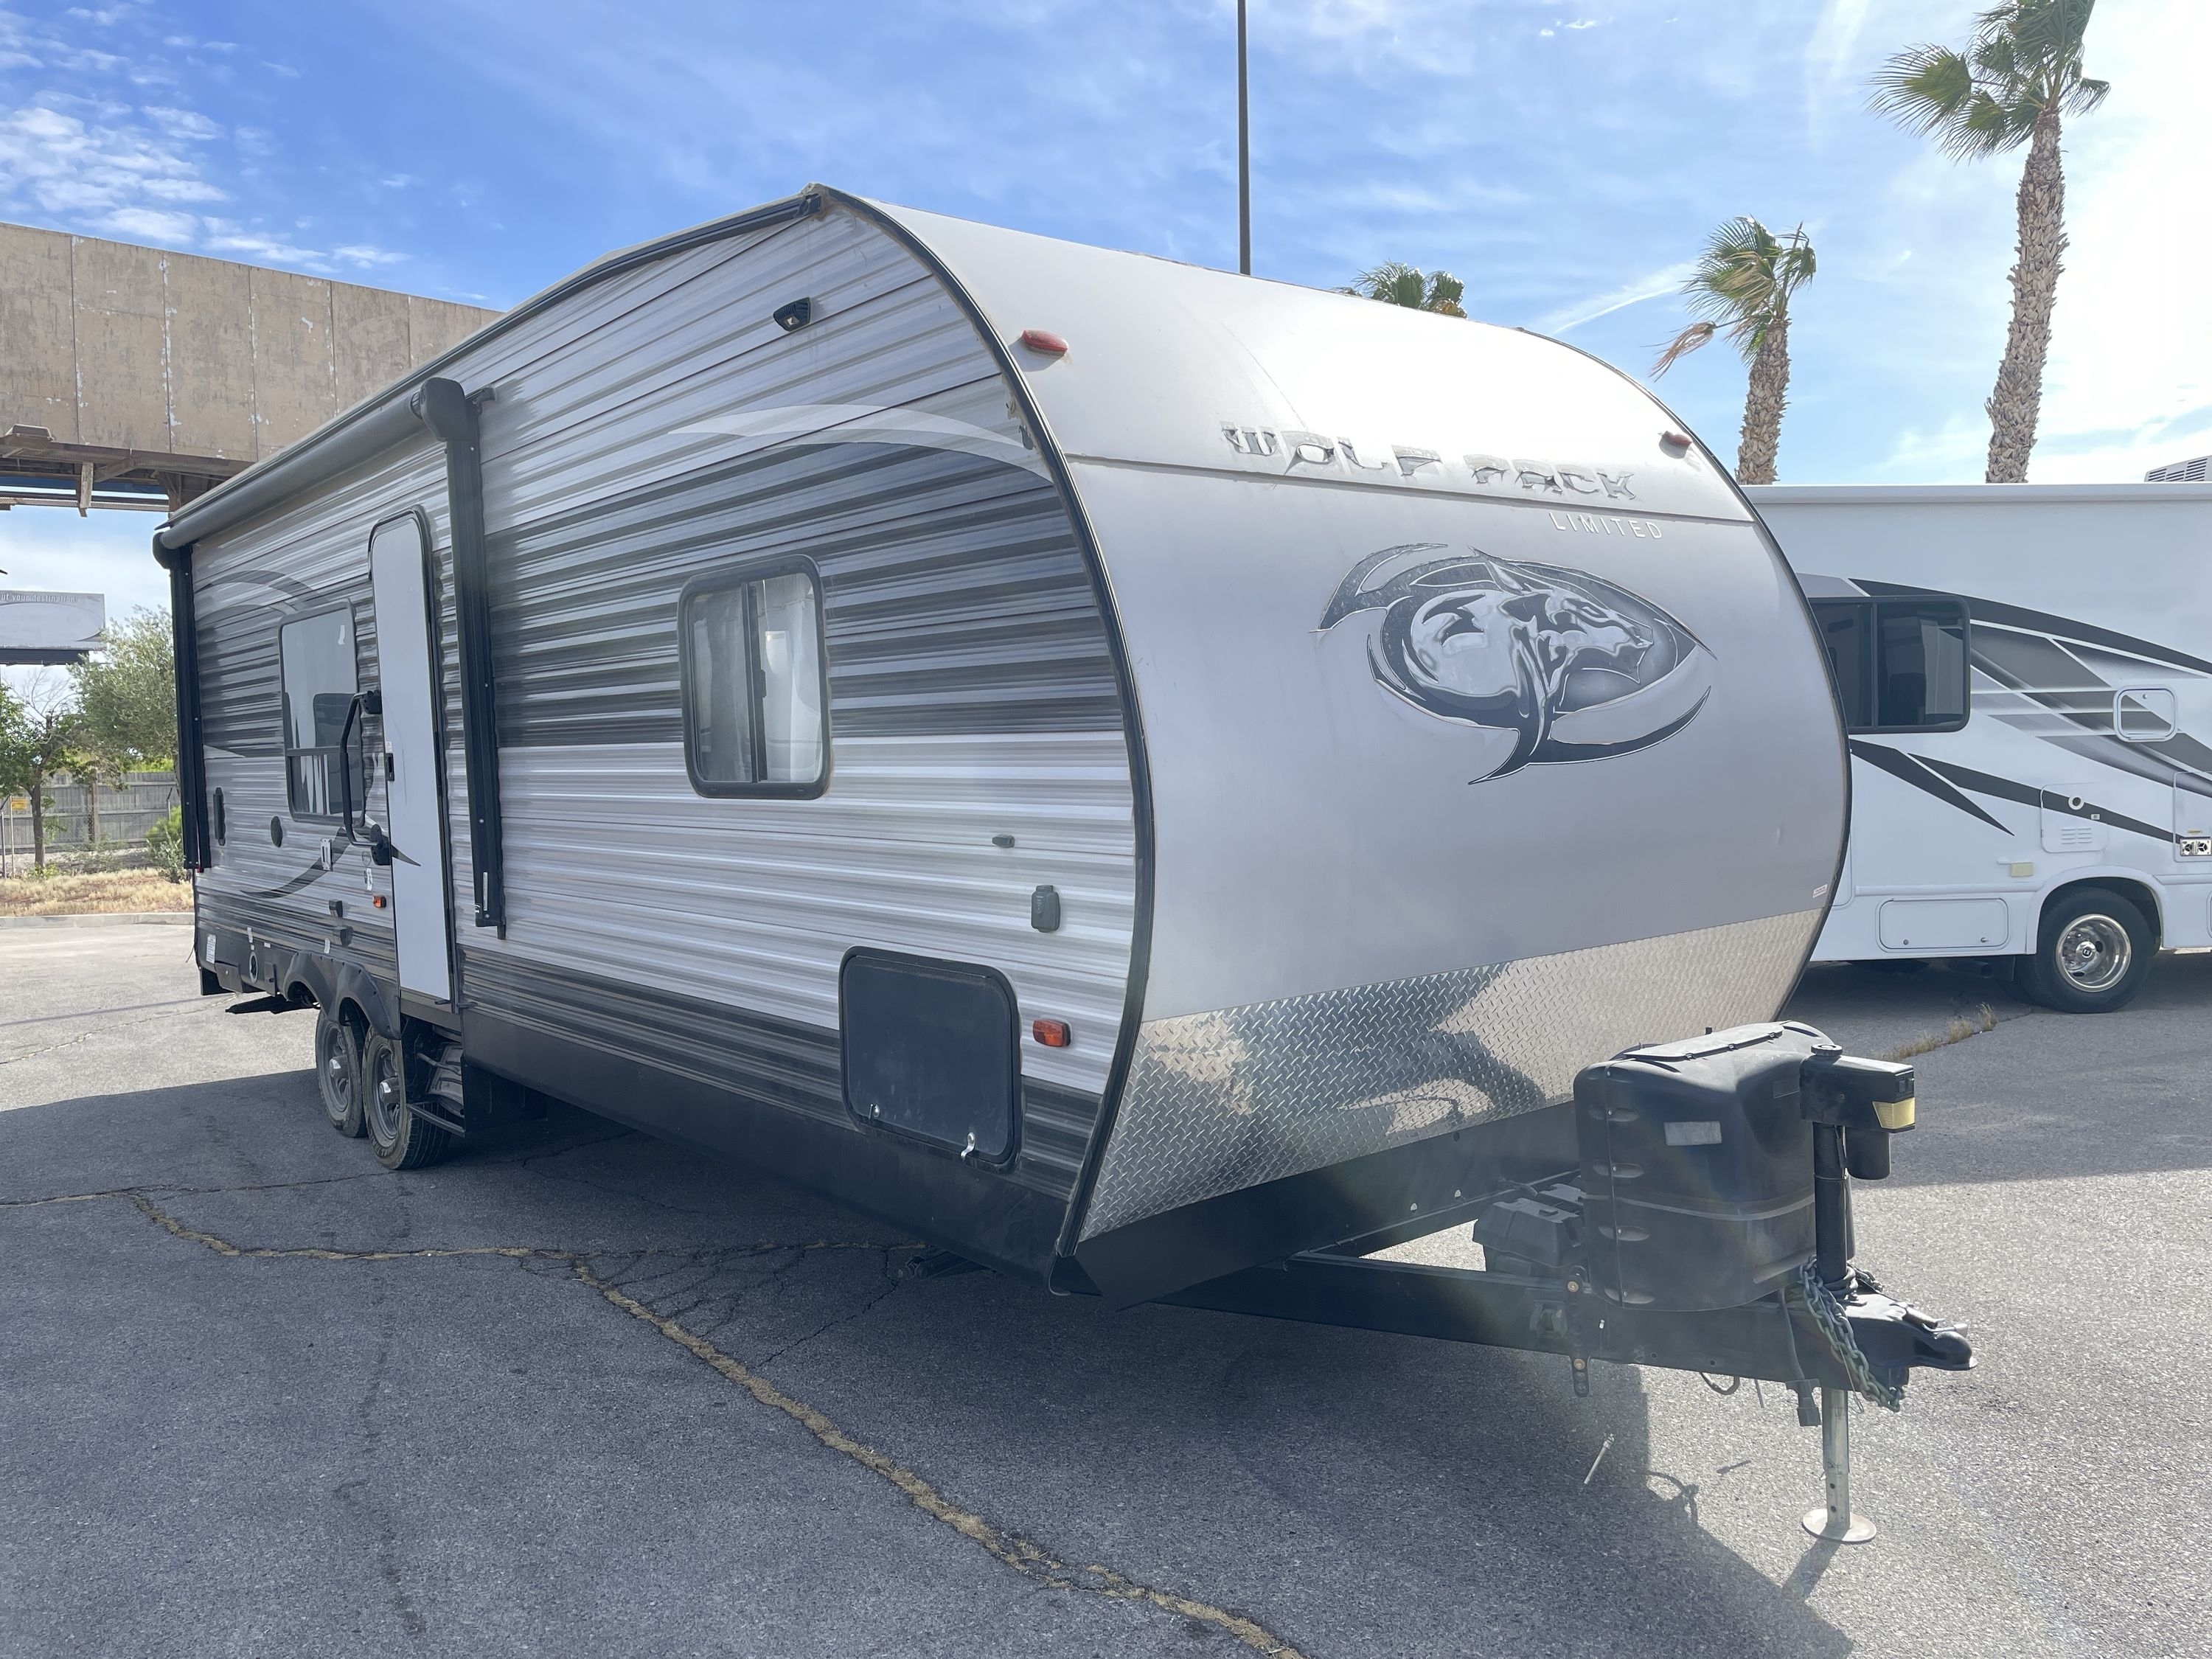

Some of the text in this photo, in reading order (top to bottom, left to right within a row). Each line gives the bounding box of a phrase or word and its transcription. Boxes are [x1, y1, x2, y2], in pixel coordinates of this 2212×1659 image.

[1219, 420, 1643, 502] WOLF PACK
[1549, 512, 1662, 539] LIMITED
[12, 594, 29, 602] your
